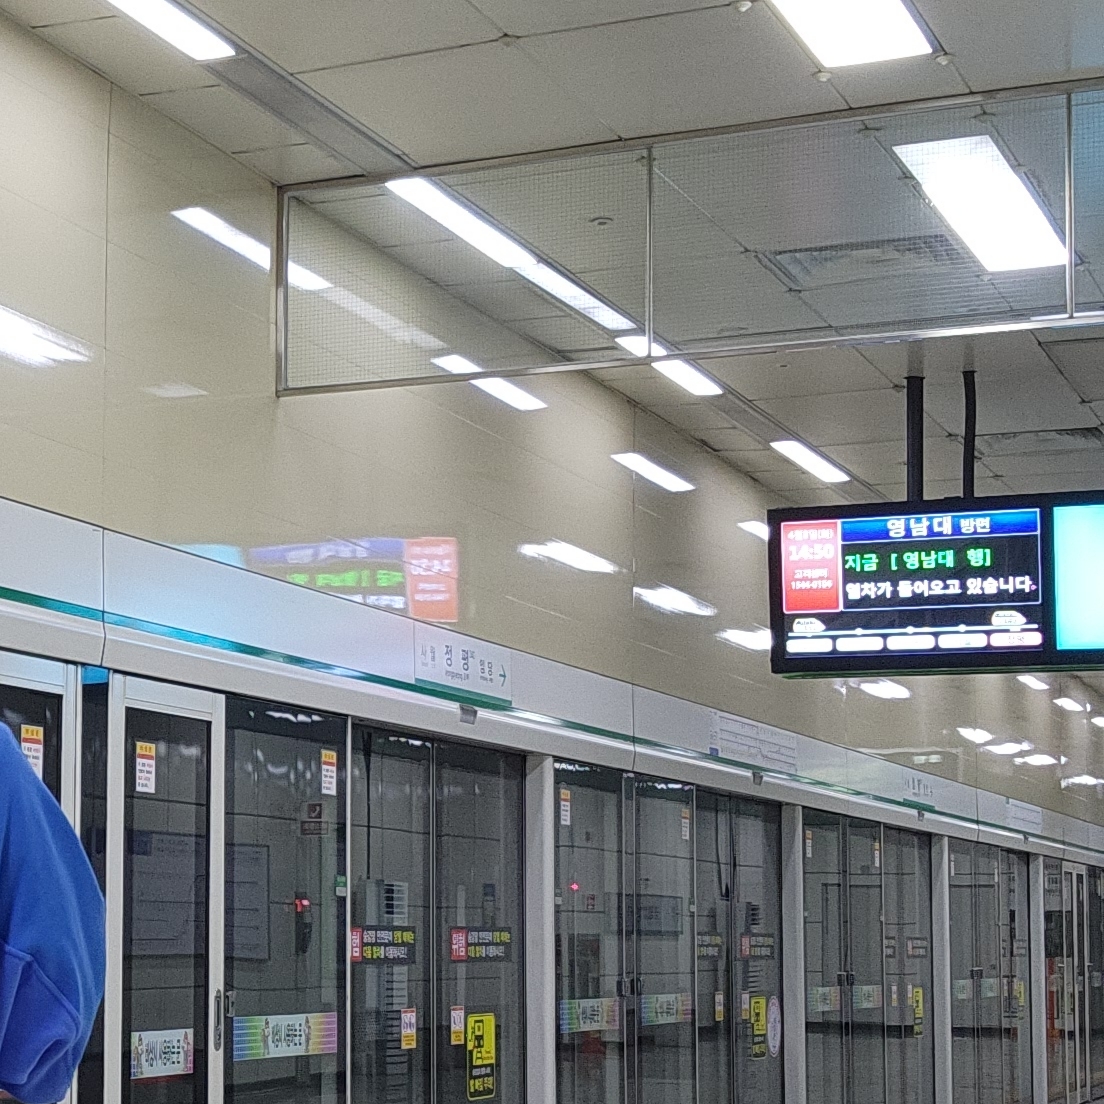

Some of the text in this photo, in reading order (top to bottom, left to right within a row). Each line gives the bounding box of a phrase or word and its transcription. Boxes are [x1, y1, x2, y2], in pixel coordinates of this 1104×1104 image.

[887, 516, 991, 538] 영남대 방면
[845, 553, 879, 572] 지금
[845, 576, 1037, 600] 열차가 들어오고 있습니다.
